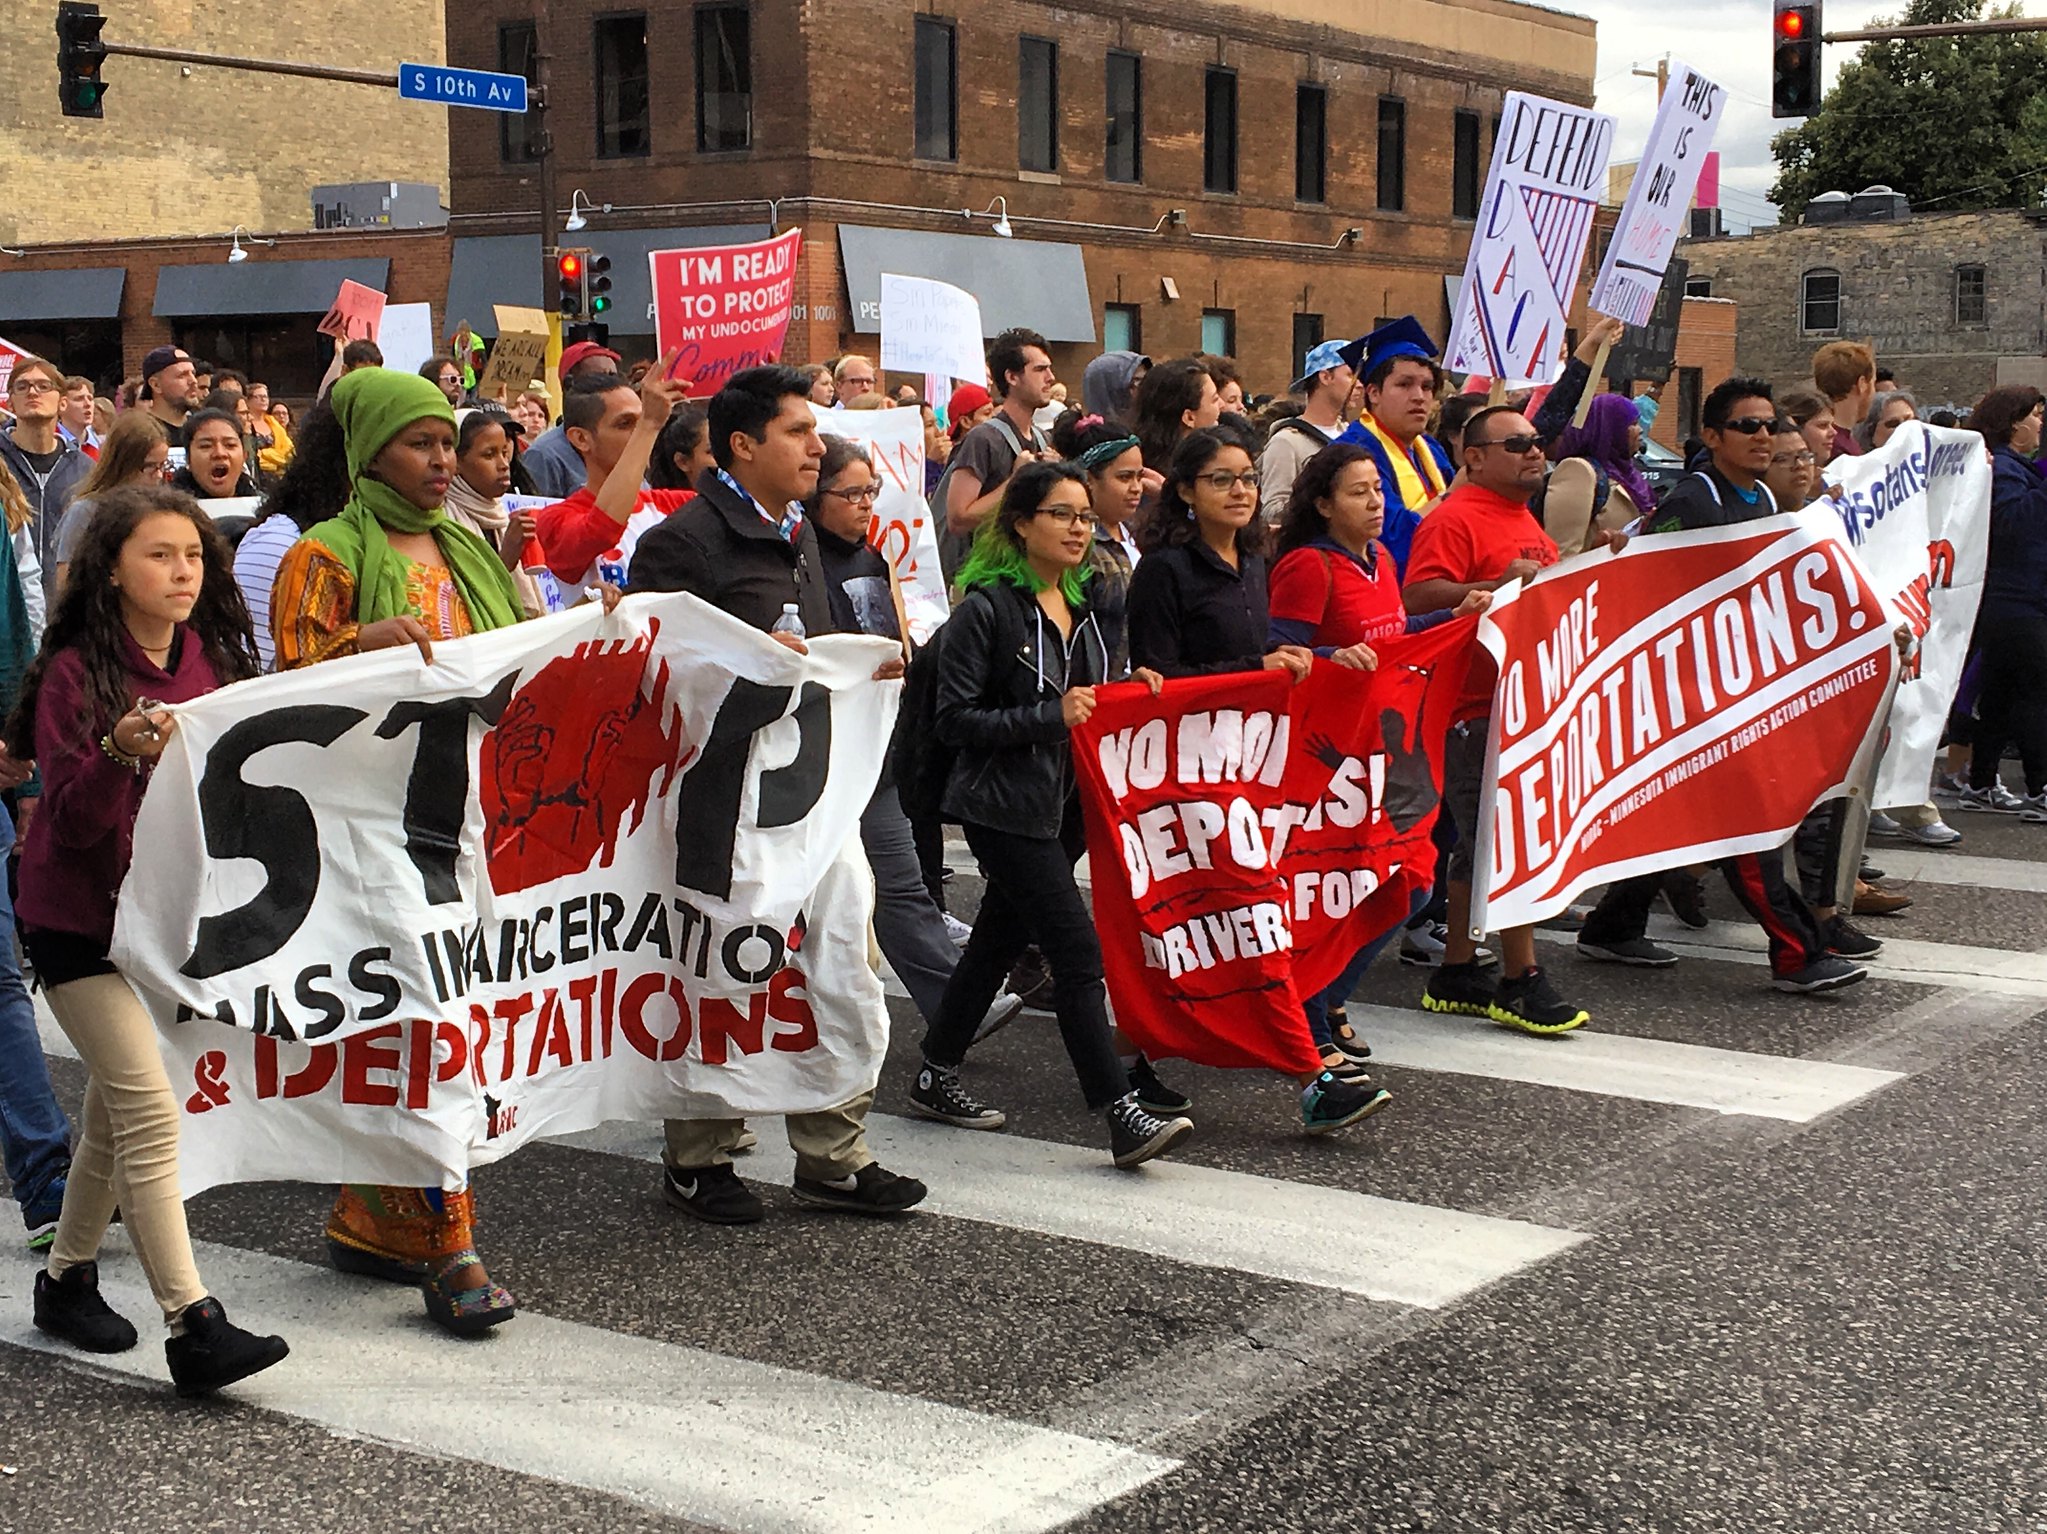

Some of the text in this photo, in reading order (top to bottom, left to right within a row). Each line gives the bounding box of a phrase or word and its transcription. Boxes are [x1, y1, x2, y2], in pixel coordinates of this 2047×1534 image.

[414, 72, 511, 102] S 10th Av
[1681, 71, 1720, 121] THIS
[1505, 99, 1613, 191] DEFEND
[1673, 126, 1694, 159] IS
[679, 240, 792, 286] I'M READY
[680, 293, 716, 319] TO
[724, 277, 791, 316] PROTECT
[682, 306, 788, 341] MY UNDOCUM
[1500, 579, 1600, 740] O MORE
[1489, 541, 1866, 894] DEPORTATIONS!
[1609, 776, 1665, 827] MINNESOTA
[1664, 740, 1729, 790] IMMIGRANT
[1730, 717, 1770, 754] RIGHTS
[1769, 694, 1809, 731] ACTION
[1808, 658, 1879, 708] COMMITTEE
[1140, 899, 1294, 981] DRIVER
[185, 1050, 231, 1115] &
